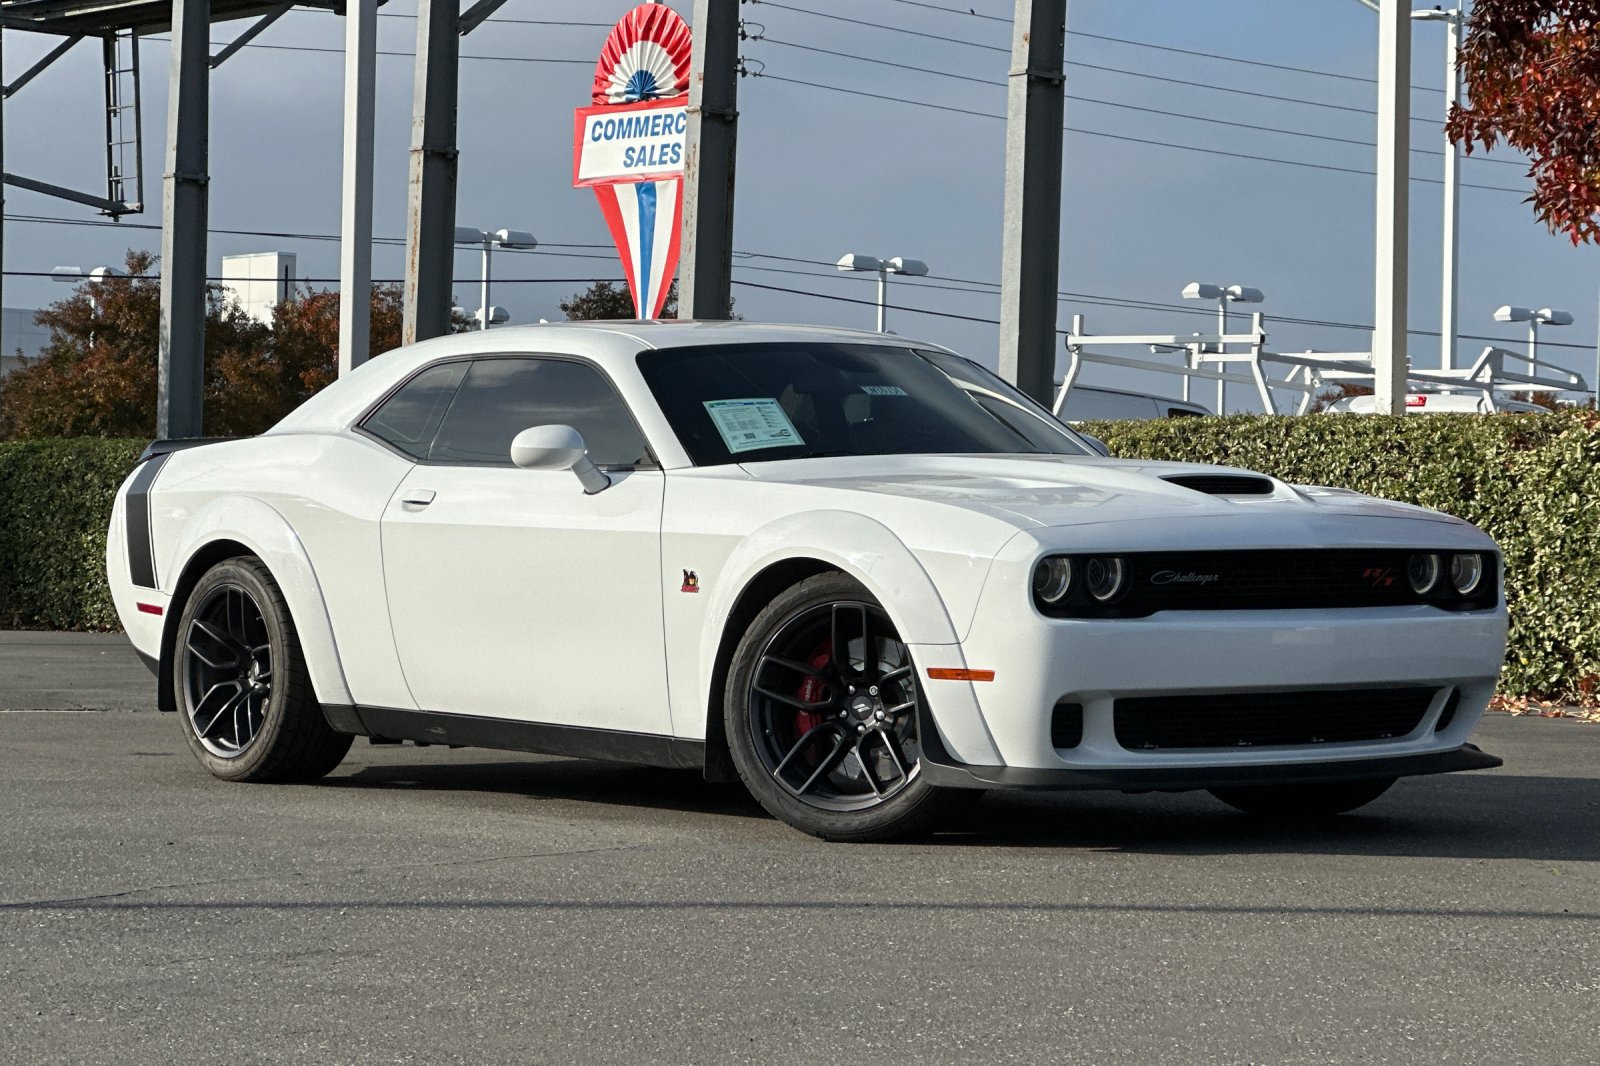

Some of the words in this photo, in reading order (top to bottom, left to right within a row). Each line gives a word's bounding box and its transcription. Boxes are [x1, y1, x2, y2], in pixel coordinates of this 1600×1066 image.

[591, 112, 687, 142] COMMERC
[623, 142, 682, 168] SALES
[1150, 570, 1220, 586] Challenger
